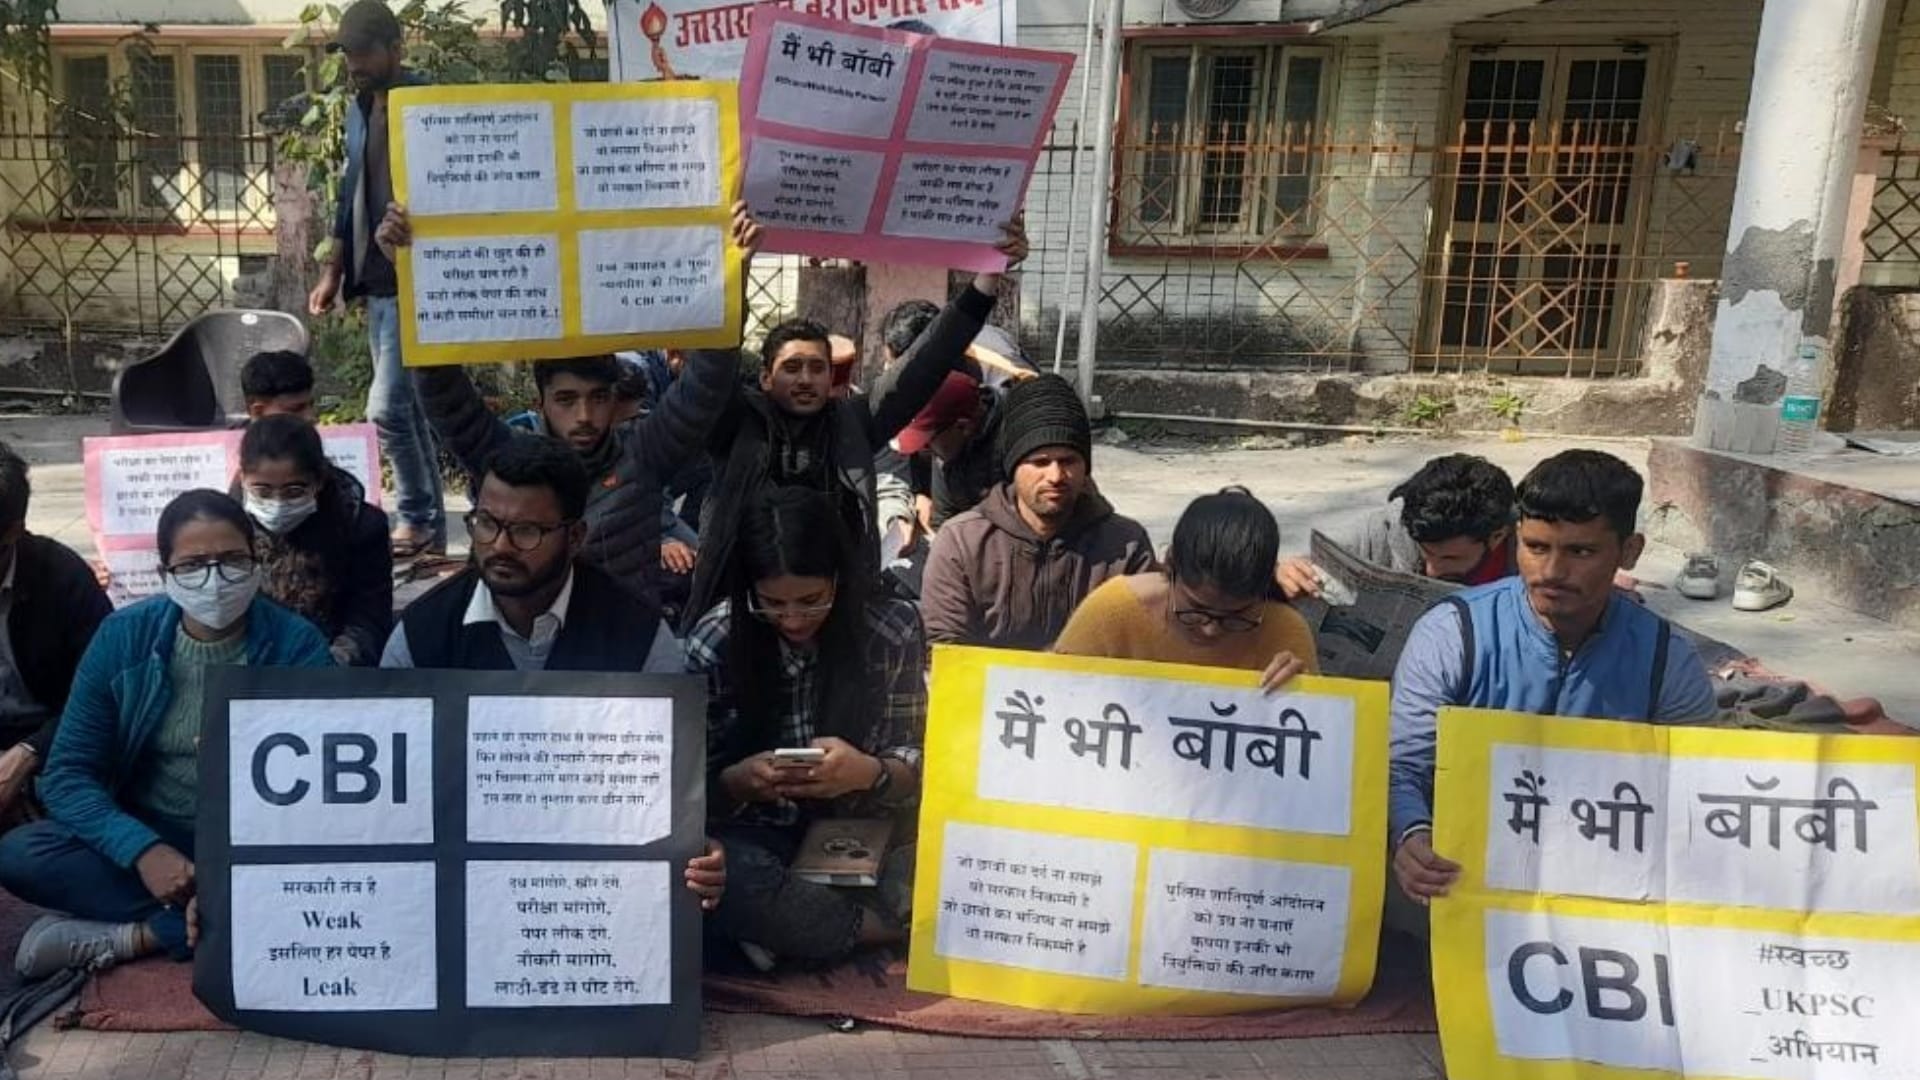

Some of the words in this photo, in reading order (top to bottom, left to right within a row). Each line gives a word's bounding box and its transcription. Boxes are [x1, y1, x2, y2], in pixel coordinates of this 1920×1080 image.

[781, 32, 802, 62] मैं
[807, 40, 836, 67] भी
[840, 48, 896, 79] बॉबी
[995, 688, 1047, 761] मैं
[1063, 702, 1143, 771] भी
[1168, 700, 1322, 780] बॉबी
[250, 732, 407, 806] CBI
[1503, 770, 1550, 846] मैं
[1571, 781, 1654, 853] भी
[1698, 773, 1878, 853] बॉबी
[282, 876, 336, 894] सरकारी
[366, 875, 377, 895] है
[302, 910, 363, 929] Weak
[269, 942, 322, 964] इसलिए
[326, 945, 342, 960] हर
[347, 941, 376, 959] पेपर
[380, 940, 391, 960] है
[516, 949, 561, 967] नौकरी
[1759, 942, 1851, 970] #स्वच्छ
[303, 976, 357, 997] Leak
[1507, 940, 1675, 1026] CBI
[1743, 987, 1875, 1018] _UKPSC
[1750, 1029, 1880, 1065] _अभियान
